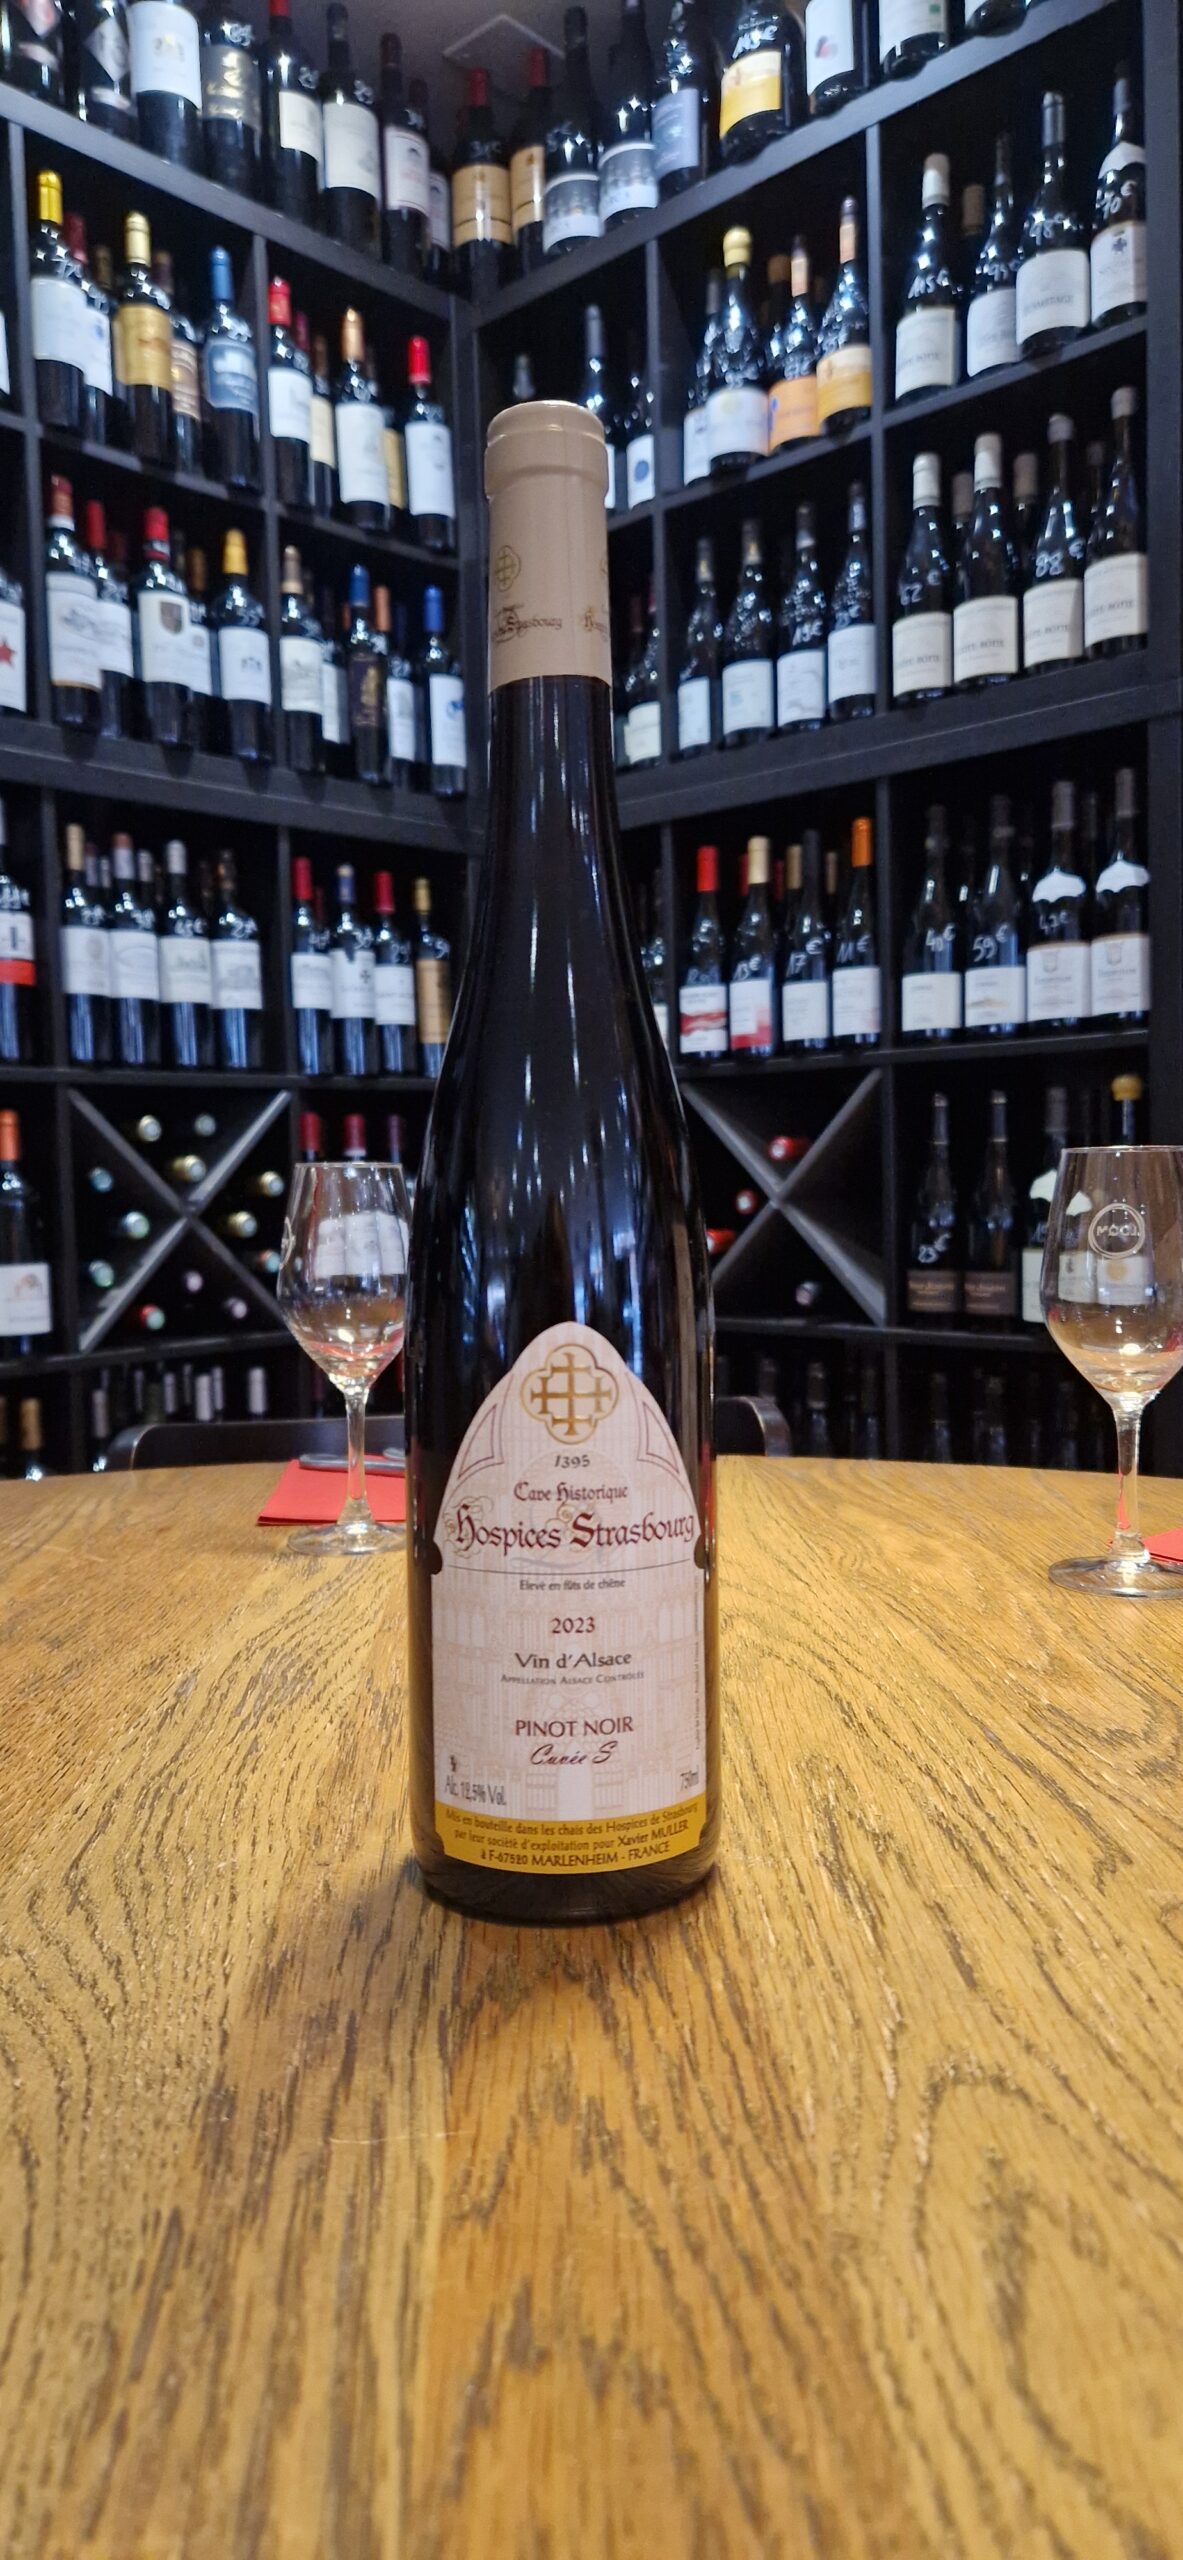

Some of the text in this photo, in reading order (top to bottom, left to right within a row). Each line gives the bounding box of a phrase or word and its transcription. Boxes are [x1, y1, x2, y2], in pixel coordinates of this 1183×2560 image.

[554, 1454, 591, 1469] 1395
[513, 1481, 628, 1503] Cave Historique
[456, 1503, 695, 1557] Hospices Strasbourg
[548, 1582, 561, 1591] en
[583, 1579, 595, 1590] de
[551, 1616, 596, 1635] 2023
[515, 1652, 632, 1669] Vin d'Alsace
[515, 1716, 634, 1737] PINOT NOIR
[530, 1740, 618, 1765] Cuvée S
[515, 1823, 539, 1836] dans
[541, 1824, 555, 1836] les
[558, 1823, 584, 1836] chais
[586, 1823, 603, 1835] des
[606, 1818, 648, 1833] Hospices
[650, 1814, 661, 1826] de
[617, 1833, 649, 1848] Xavier
[651, 1819, 689, 1840] MULLER
[532, 1852, 618, 1869] MARLENHEIM
[628, 1841, 670, 1861] FRANCE
